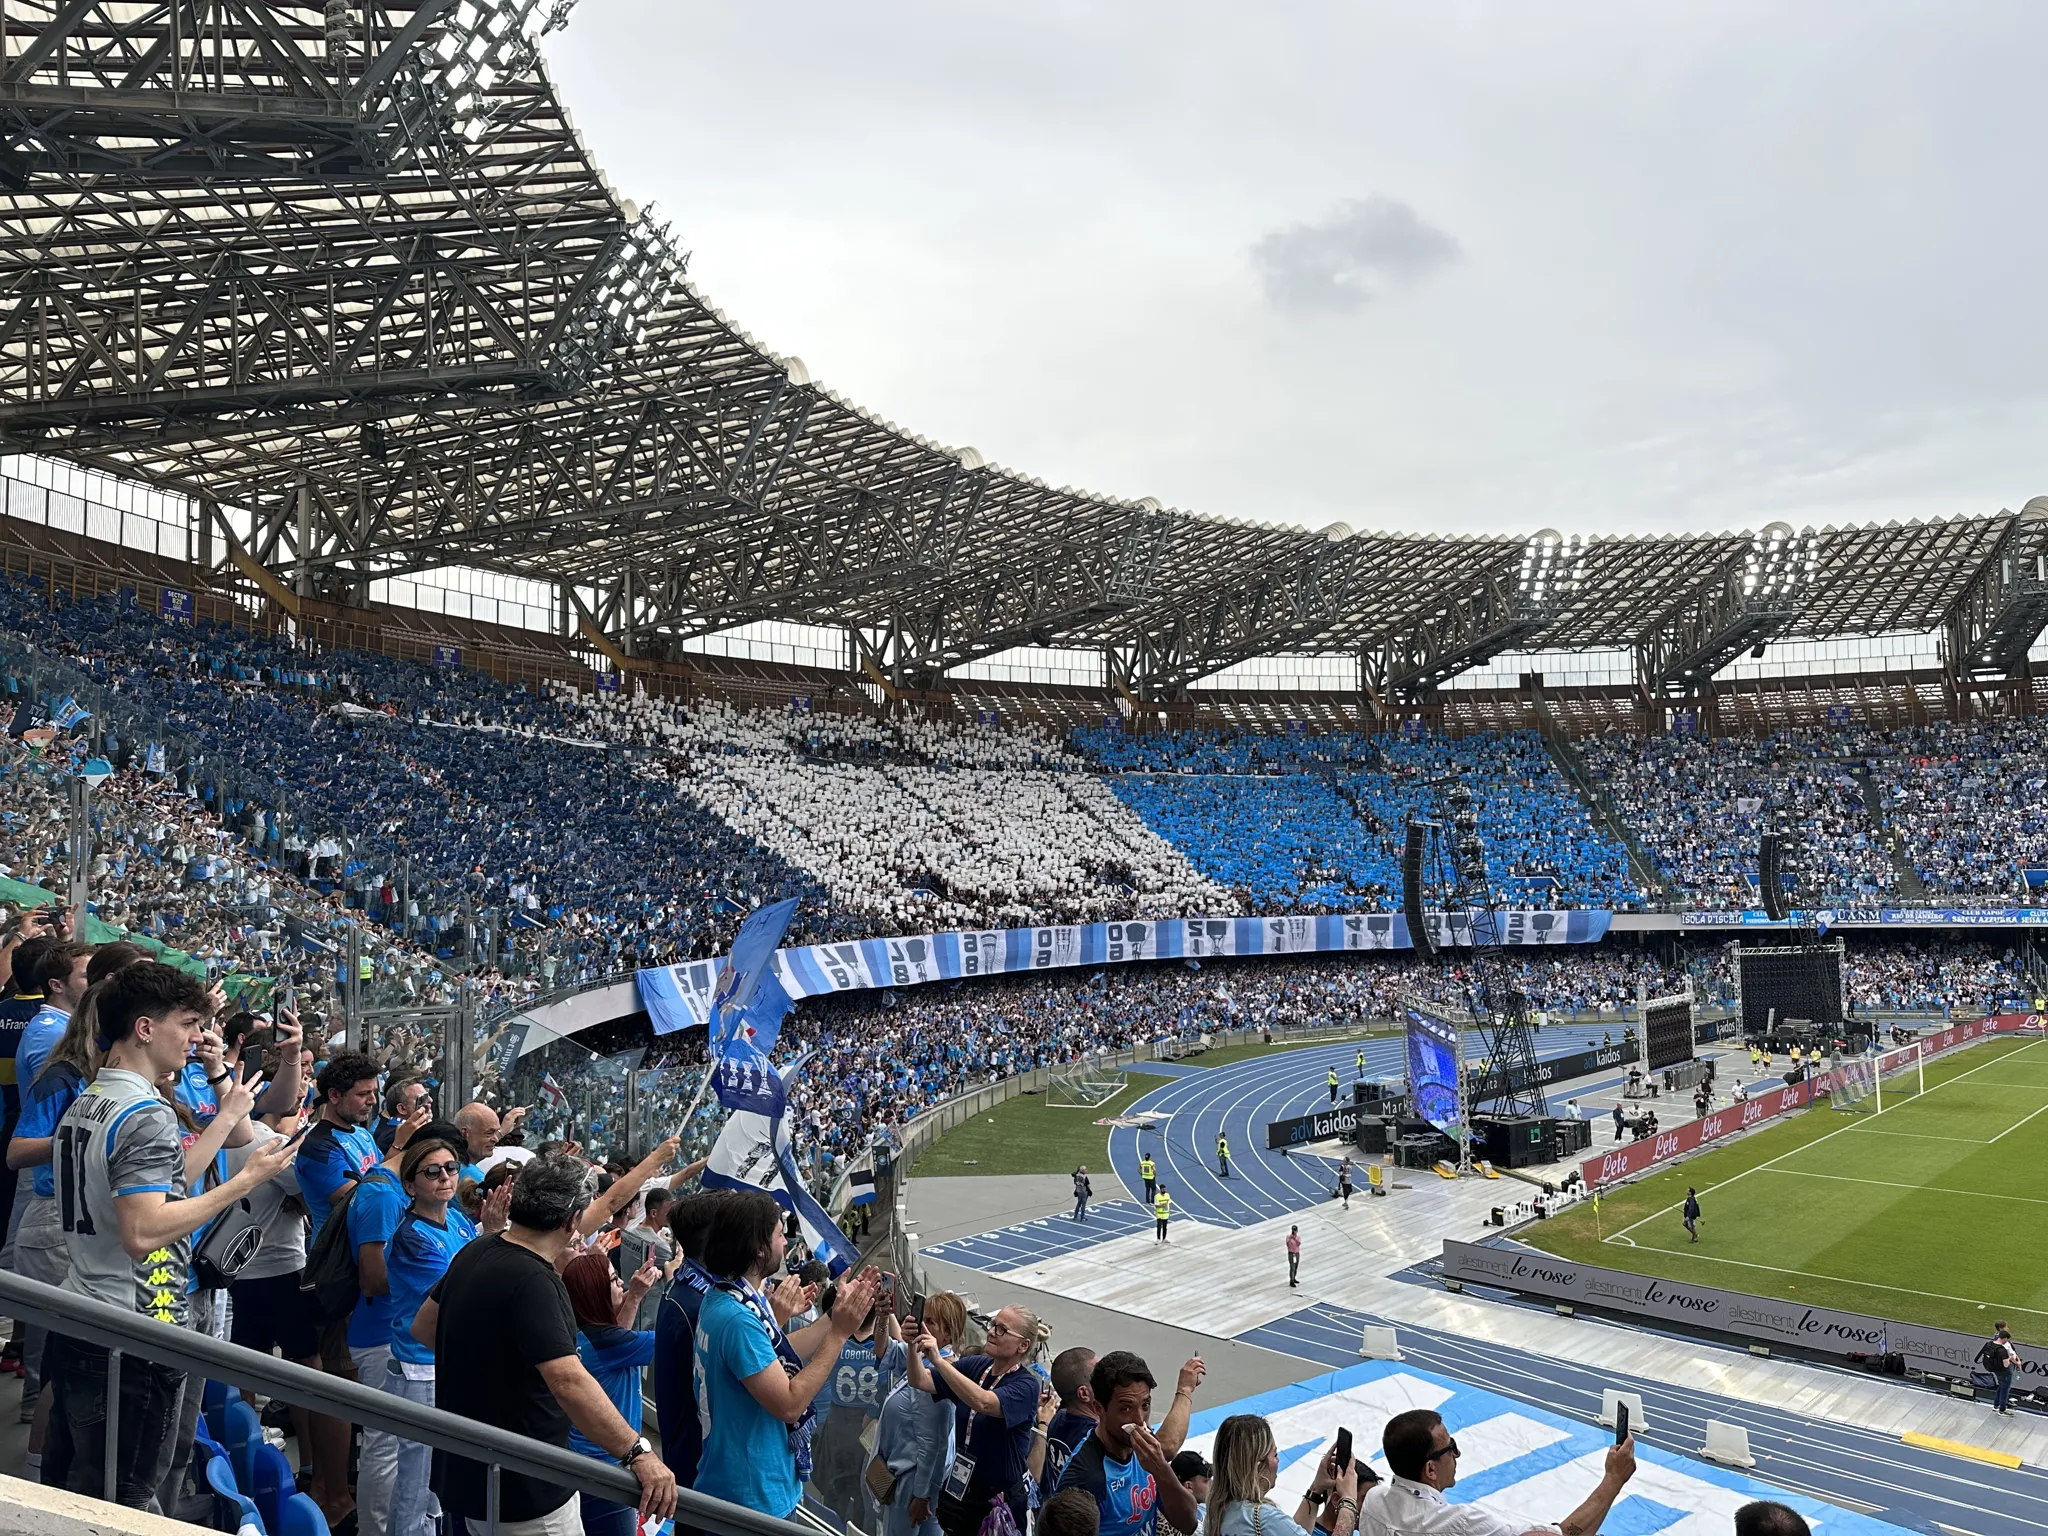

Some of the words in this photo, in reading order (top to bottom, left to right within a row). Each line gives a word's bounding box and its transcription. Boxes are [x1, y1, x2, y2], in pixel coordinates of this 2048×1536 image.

[168, 591, 187, 600] SECTOR
[1682, 915, 1705, 924] ISOLA
[1708, 915, 1744, 924] D'ISCHIA
[1602, 1152, 1628, 1181] Lete
[1652, 1133, 1679, 1161] Lete
[1700, 1115, 1722, 1141] Lete
[1742, 1099, 1762, 1125] Lete
[1780, 1087, 1799, 1110] Lete
[1815, 1075, 1831, 1097] Lete
[1982, 1015, 1998, 1032] Lete
[1458, 1253, 1509, 1273] allestimenti
[1510, 1256, 1530, 1278] le
[1531, 1268, 1576, 1286] rose
[1584, 1277, 1643, 1299] allestimenti
[1644, 1281, 1667, 1303] le
[1667, 1293, 1719, 1313] rose
[1729, 1304, 1795, 1330] allestimenti
[1797, 1310, 1822, 1333] le
[1823, 1323, 1883, 1344] rose
[1895, 1336, 1970, 1363] allestimenti
[836, 1365, 879, 1403] 68
[1126, 1474, 1157, 1524] Let
